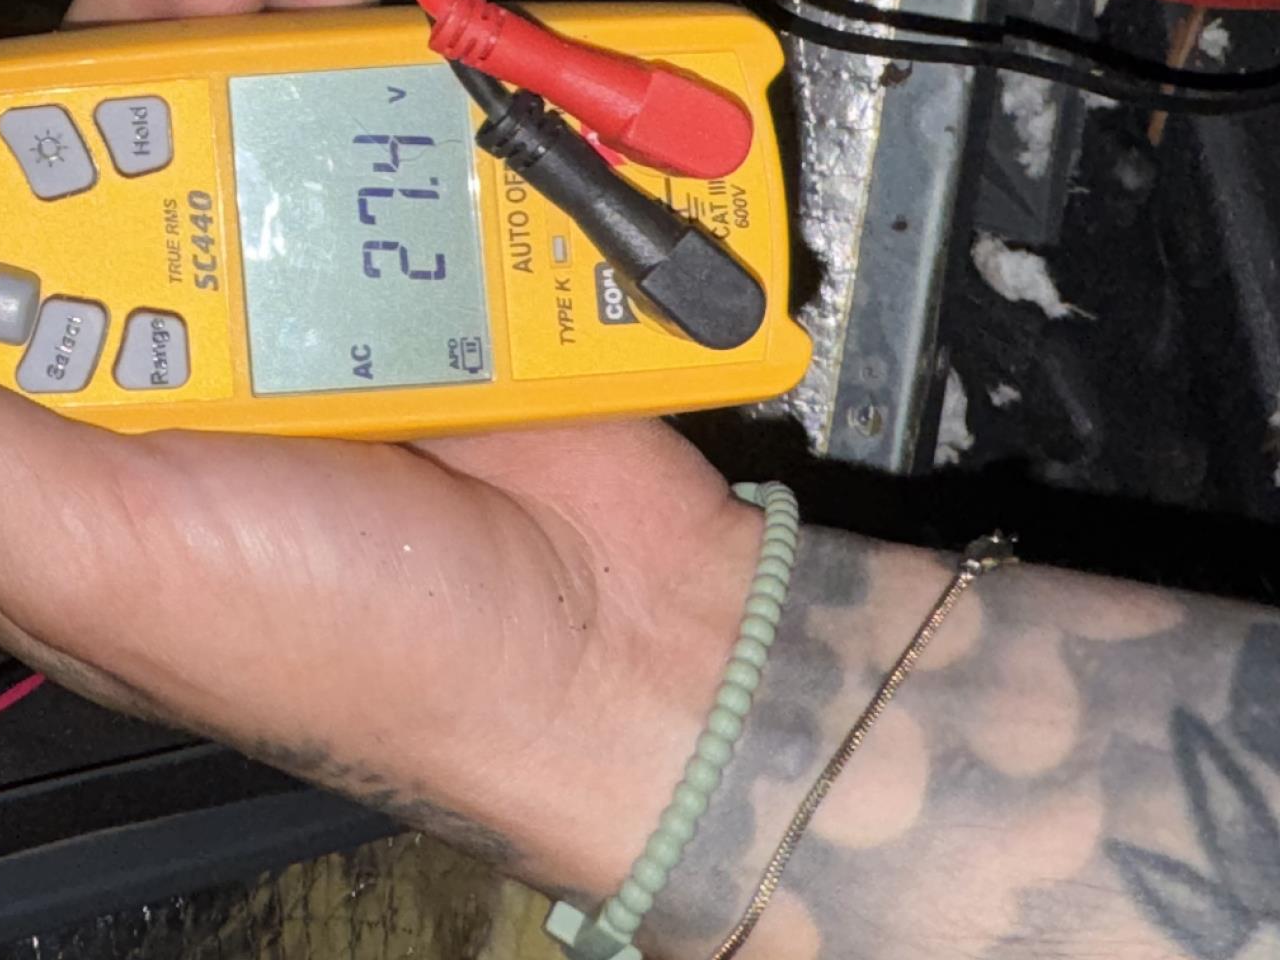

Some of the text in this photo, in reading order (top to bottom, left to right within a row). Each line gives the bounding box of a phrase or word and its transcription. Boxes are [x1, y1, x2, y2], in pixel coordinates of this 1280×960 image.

[128, 104, 151, 156] Hold
[350, 84, 447, 284] 27.4 V
[730, 182, 750, 229] 600V
[162, 197, 182, 285] TRUE RMS
[186, 188, 219, 293] SC440
[507, 209, 534, 274] AUTO
[709, 199, 731, 240] CAT
[555, 276, 576, 345] TYPE K
[602, 266, 624, 320] COM
[42, 314, 85, 381] Select
[146, 316, 171, 385] Range
[349, 343, 374, 380] AC
[446, 337, 460, 370] APO
